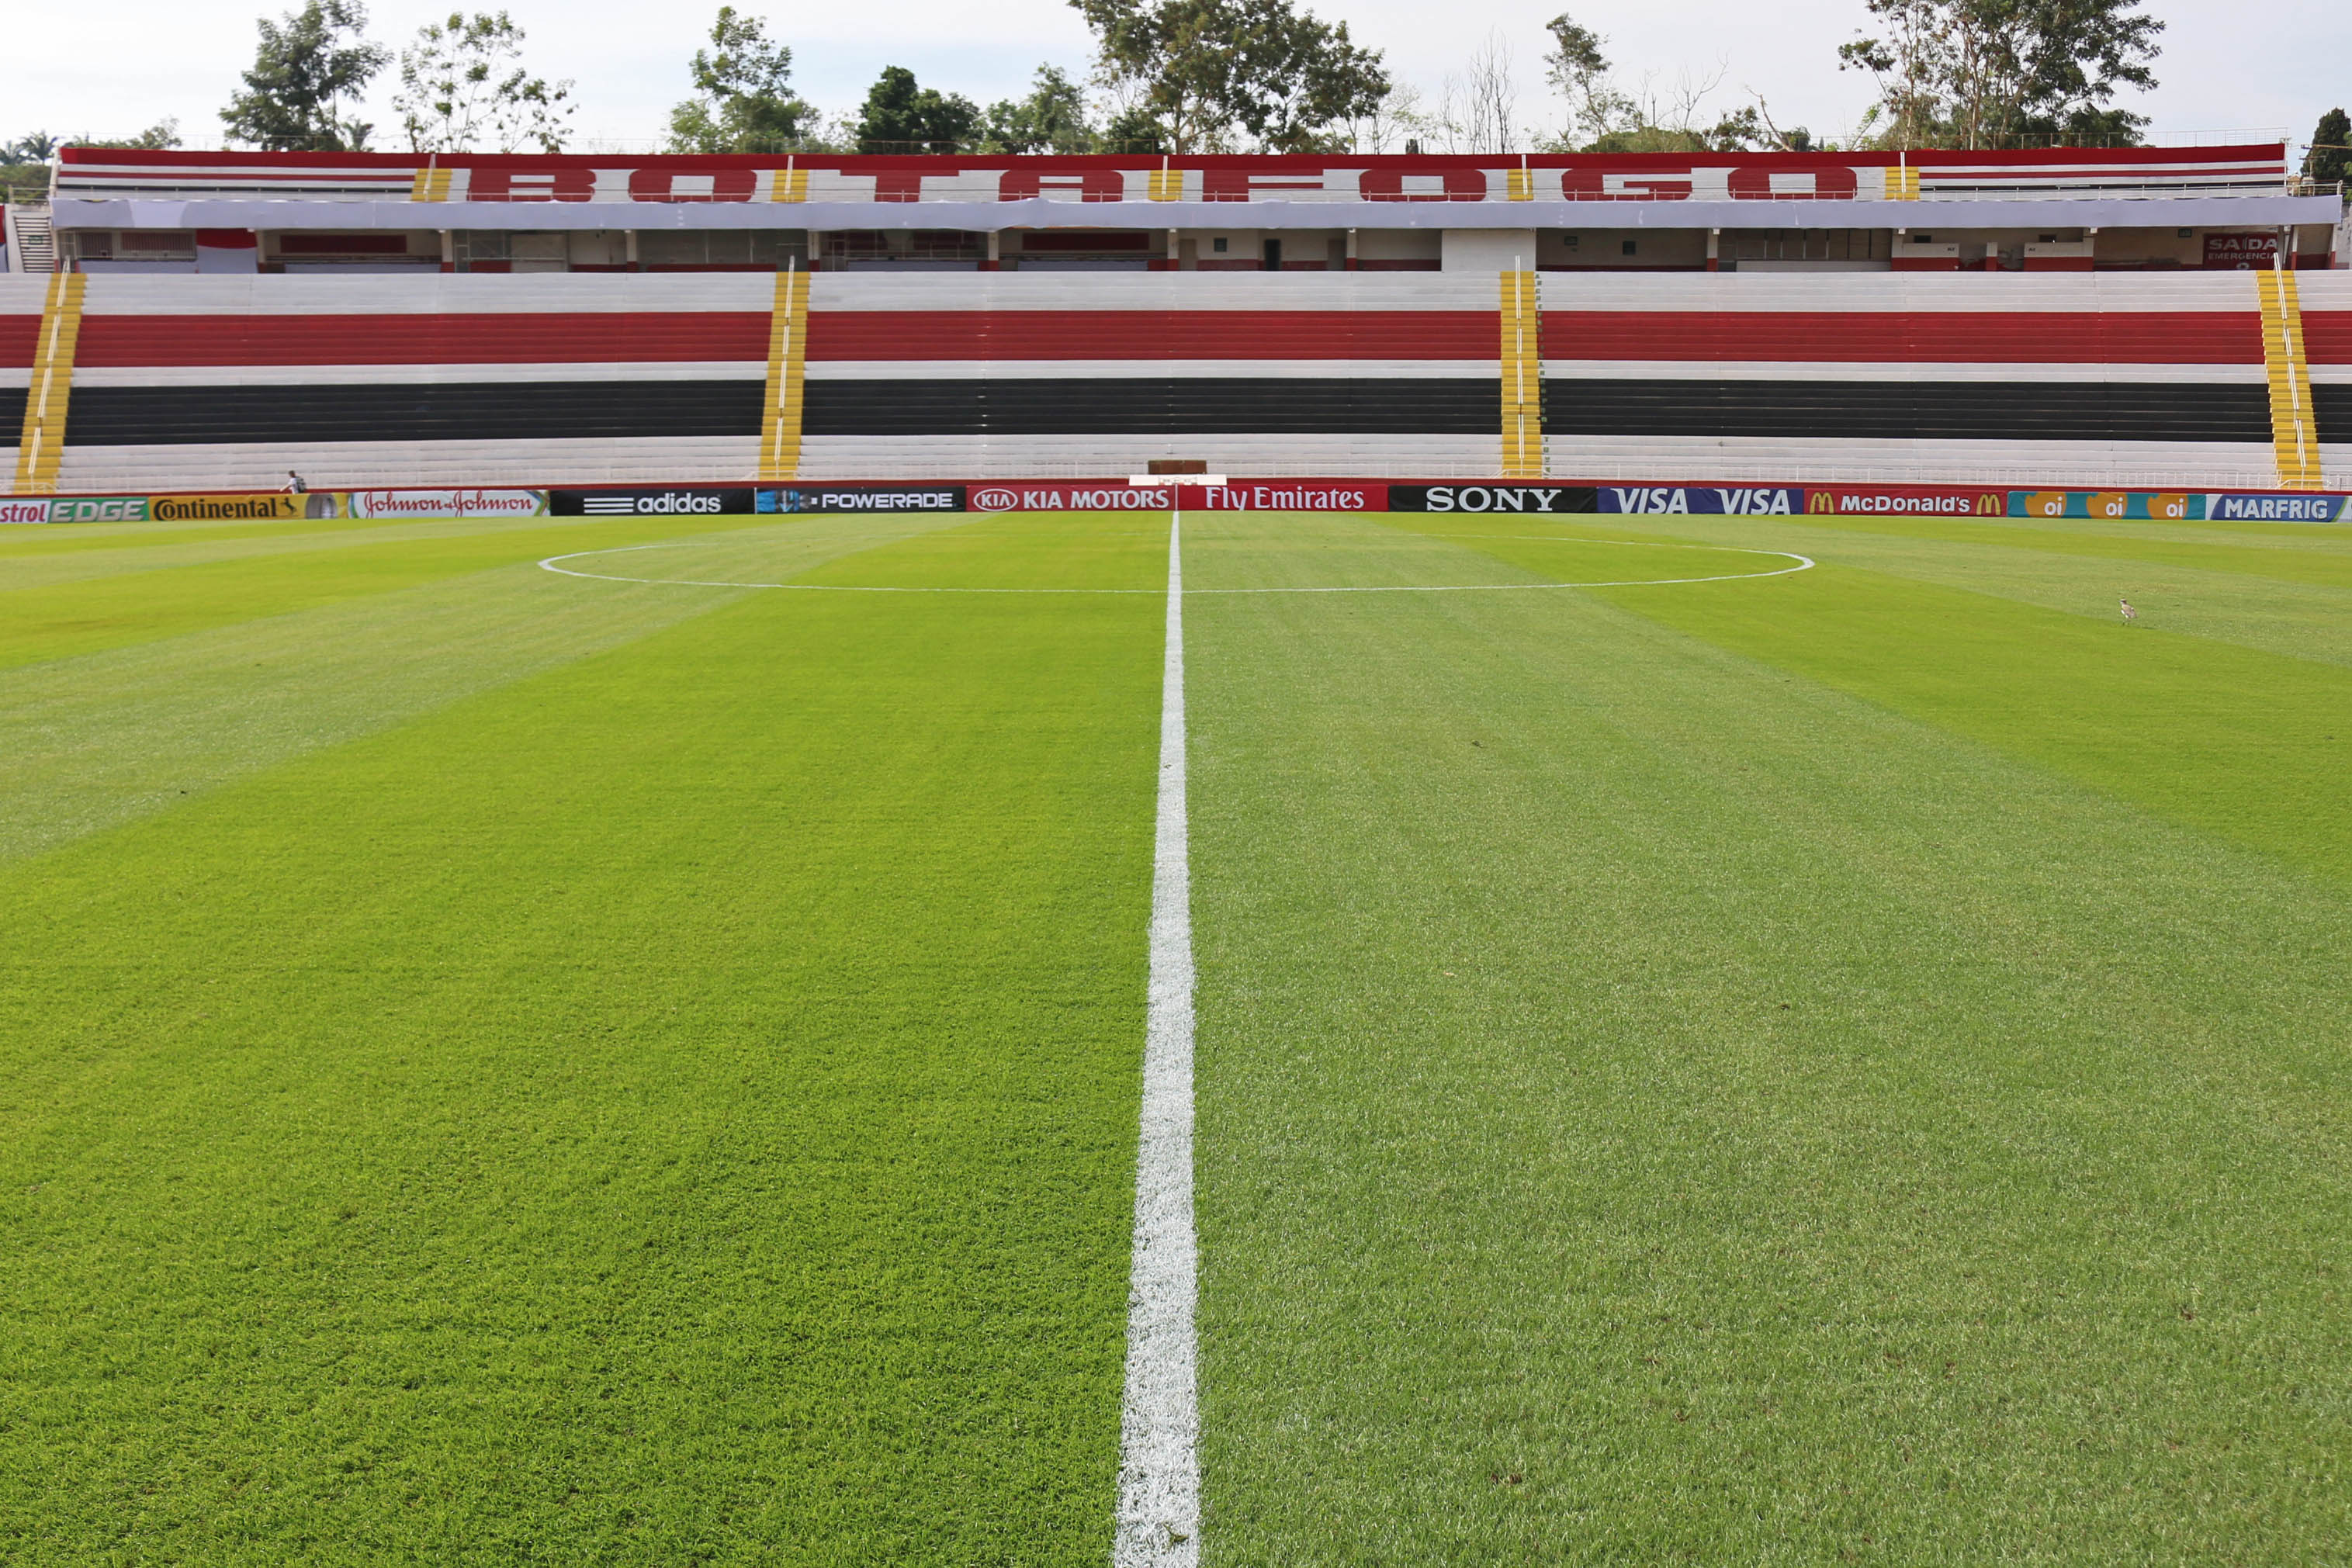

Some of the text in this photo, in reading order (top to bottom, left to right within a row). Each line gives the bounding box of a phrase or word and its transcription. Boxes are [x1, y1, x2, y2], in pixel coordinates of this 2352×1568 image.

[364, 490, 442, 518] Johnson
[452, 490, 532, 517] Johnson
[637, 493, 721, 513] adidas
[822, 493, 954, 508] POWERADE
[981, 493, 1010, 507] KIA
[1024, 490, 1169, 509] KIA MOTORS
[1205, 486, 1364, 511] Fly Emirates
[1426, 486, 1561, 511] SONY
[1609, 488, 1689, 514] VISA
[1713, 489, 1791, 515] VISA
[1841, 495, 1970, 513] McDonald's
[2044, 497, 2063, 516] oi
[2105, 497, 2123, 516] oi
[2166, 498, 2184, 517] oi
[51, 500, 147, 522] EDGE
[154, 497, 277, 521] Continental
[2224, 499, 2328, 519] MARFRIG
